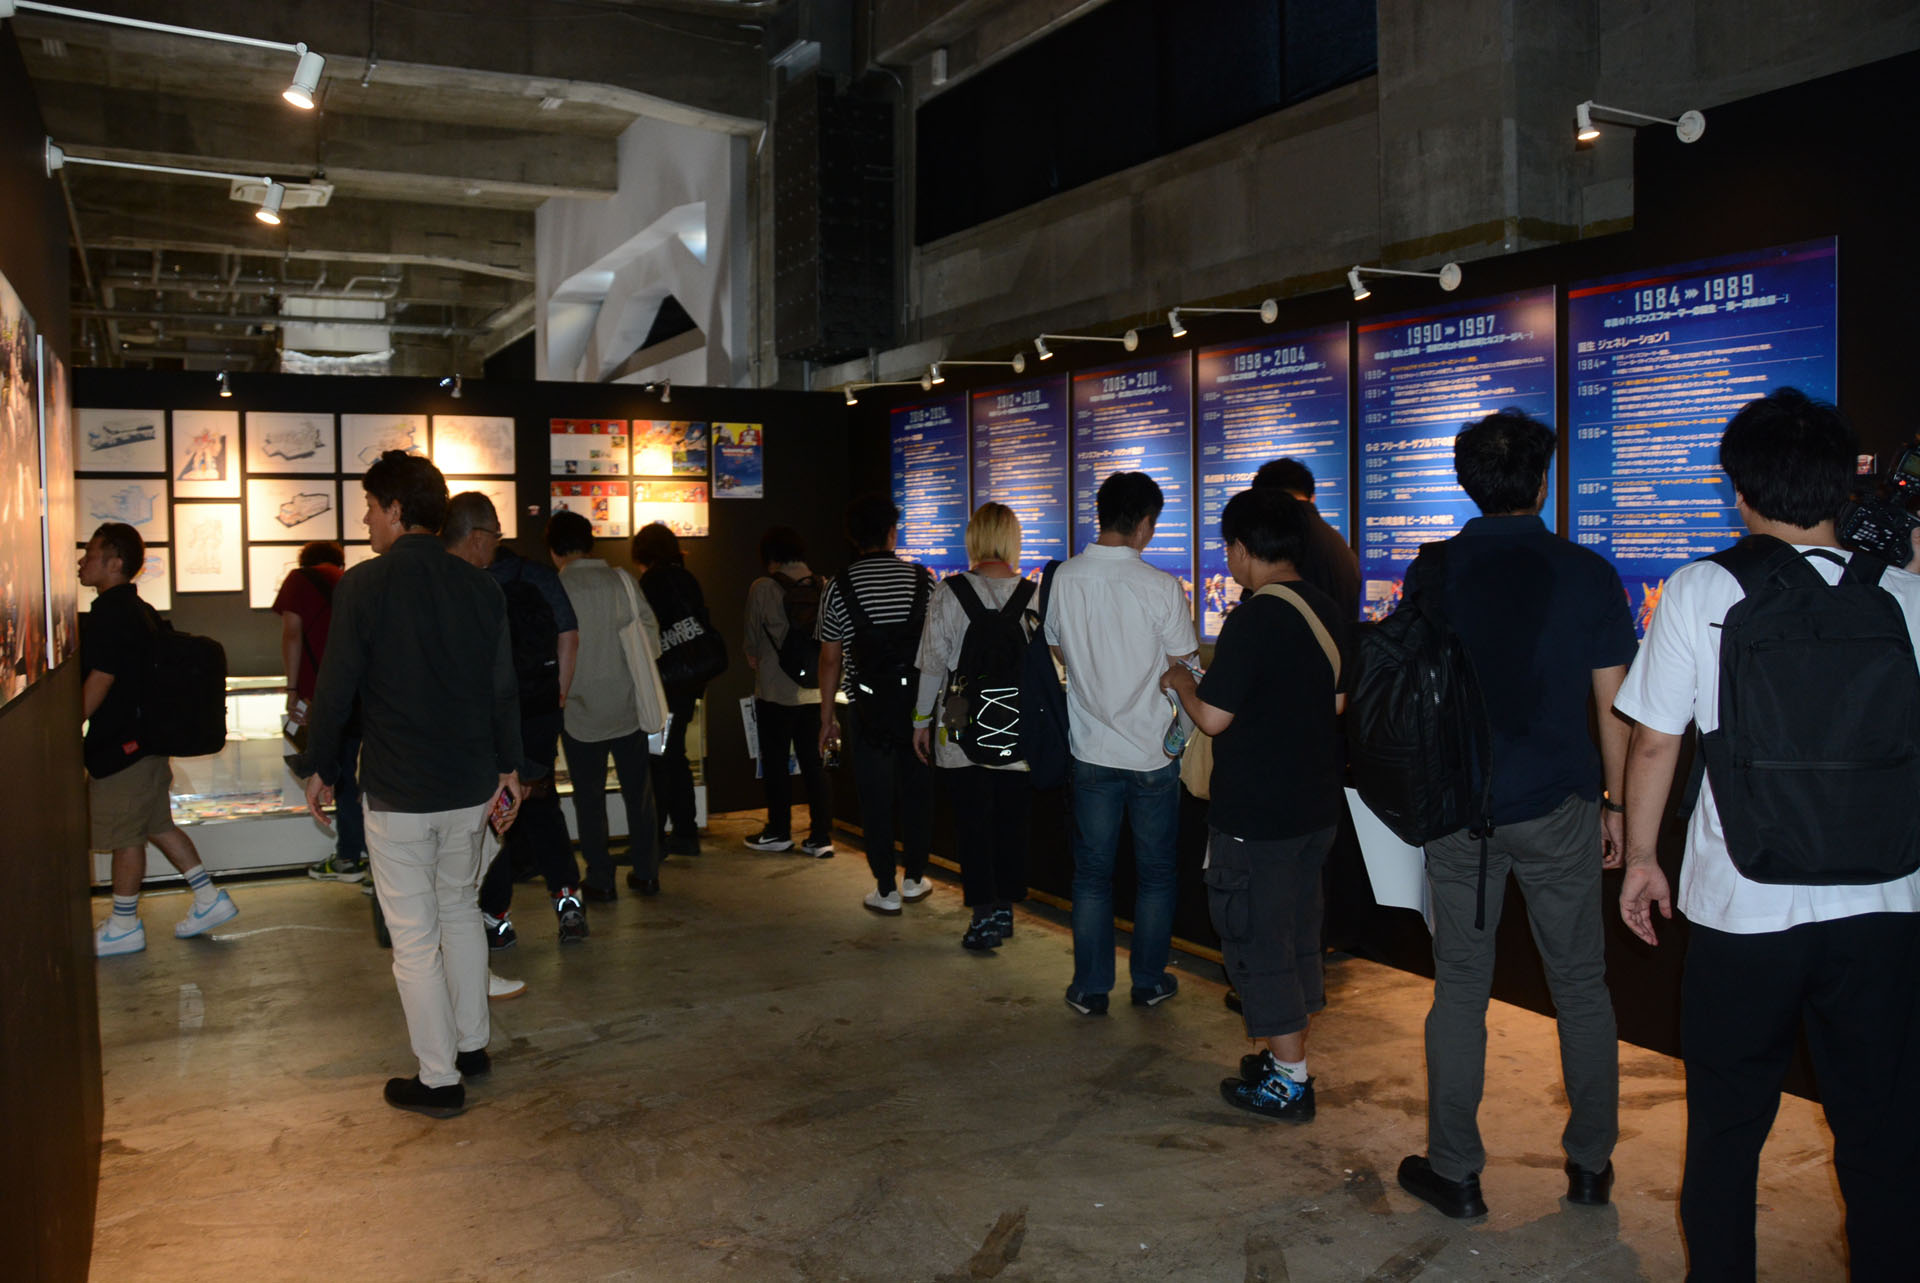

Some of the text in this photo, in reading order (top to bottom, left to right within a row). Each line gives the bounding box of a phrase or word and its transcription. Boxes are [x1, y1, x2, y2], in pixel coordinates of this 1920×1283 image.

[1633, 273, 1754, 313] 1984 1989
[1407, 323, 1442, 346] 1990
[1459, 314, 1496, 338] 1997
[1597, 331, 1670, 350] ジェネレーション1
[1234, 346, 1306, 372] 1998 2004
[1578, 359, 1600, 371] 1984
[1102, 370, 1158, 393] 2005 2011
[1578, 384, 1600, 397] 1985
